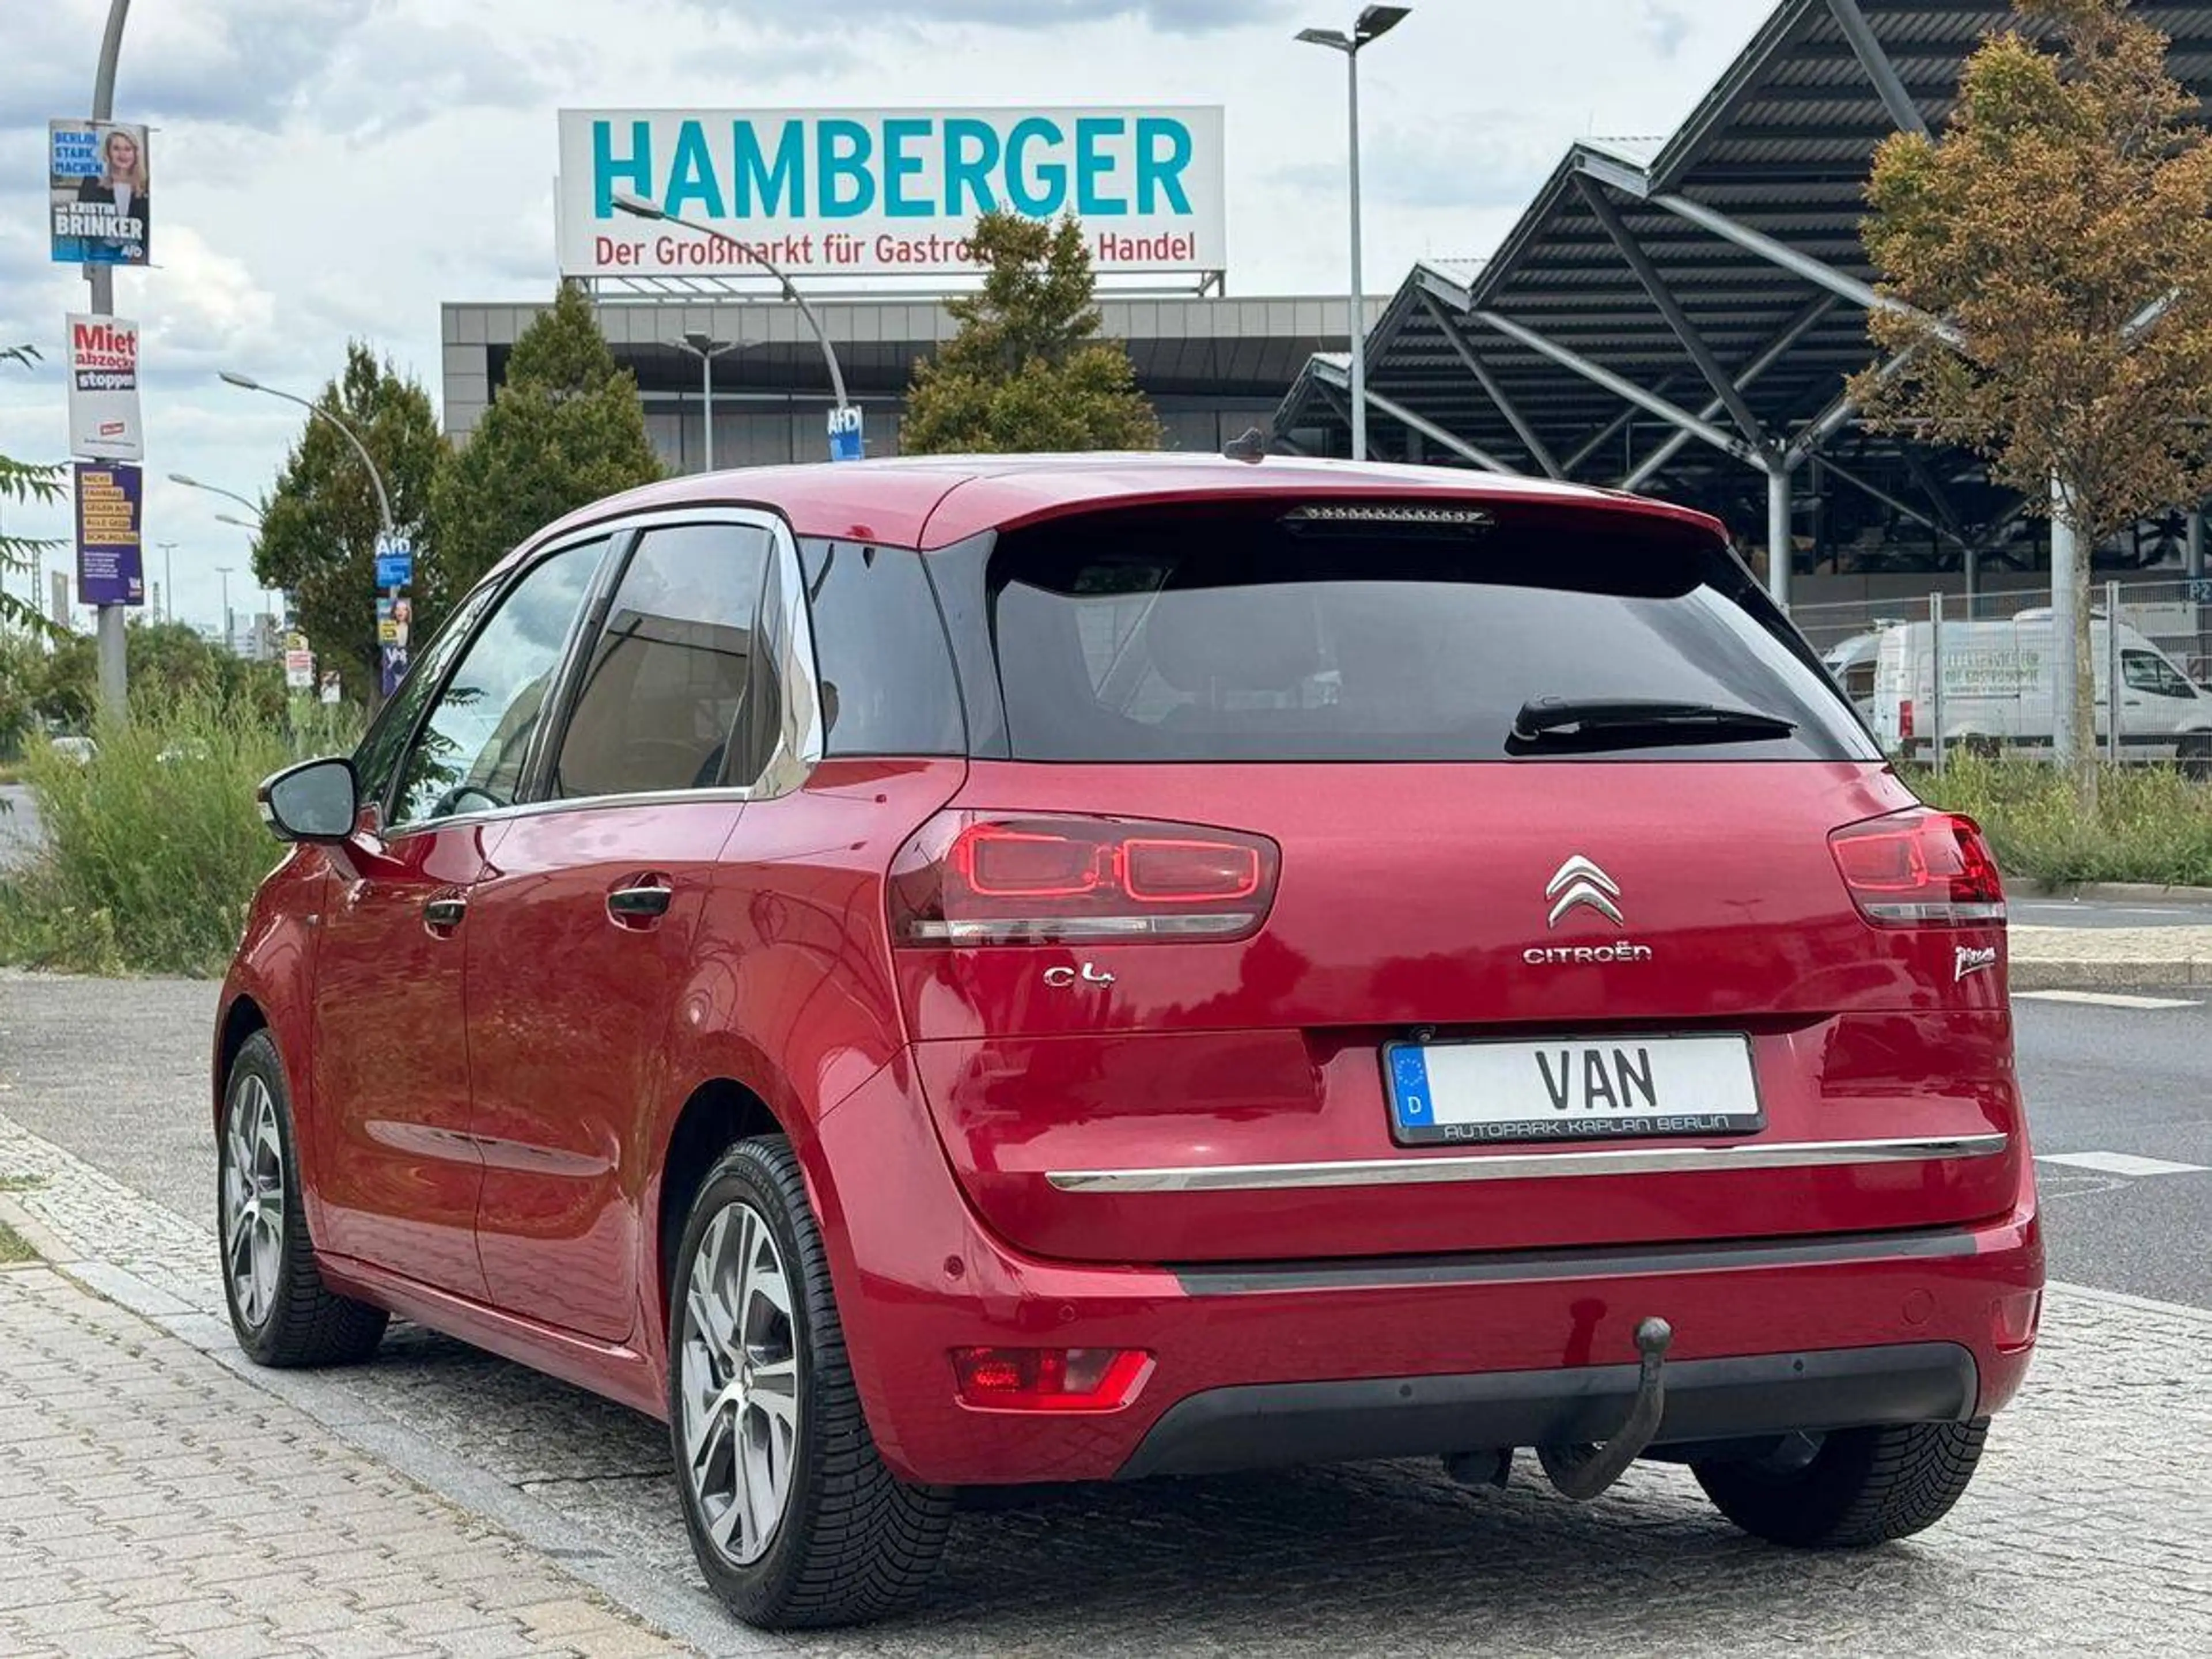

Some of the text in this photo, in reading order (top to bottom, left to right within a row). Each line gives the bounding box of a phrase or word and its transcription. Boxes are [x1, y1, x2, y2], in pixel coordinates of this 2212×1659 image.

[55, 147, 92, 158] STARK
[55, 161, 103, 174] MACHEN
[593, 117, 1193, 218] HAMBERGER
[56, 214, 142, 241] BRINKER
[596, 236, 645, 265] Der
[656, 233, 813, 265] Großmarkt
[824, 233, 865, 264] für
[1100, 232, 1195, 262] Handel
[74, 323, 135, 356] Miet
[376, 537, 411, 556] AfD
[1522, 941, 1653, 964] CITROËN
[1043, 961, 1116, 988] C4
[1535, 1047, 1657, 1109] VAN
[1408, 1096, 1423, 1115] D
[1444, 1115, 1729, 1140] AUTOPARK KAPLAN BERLIN
